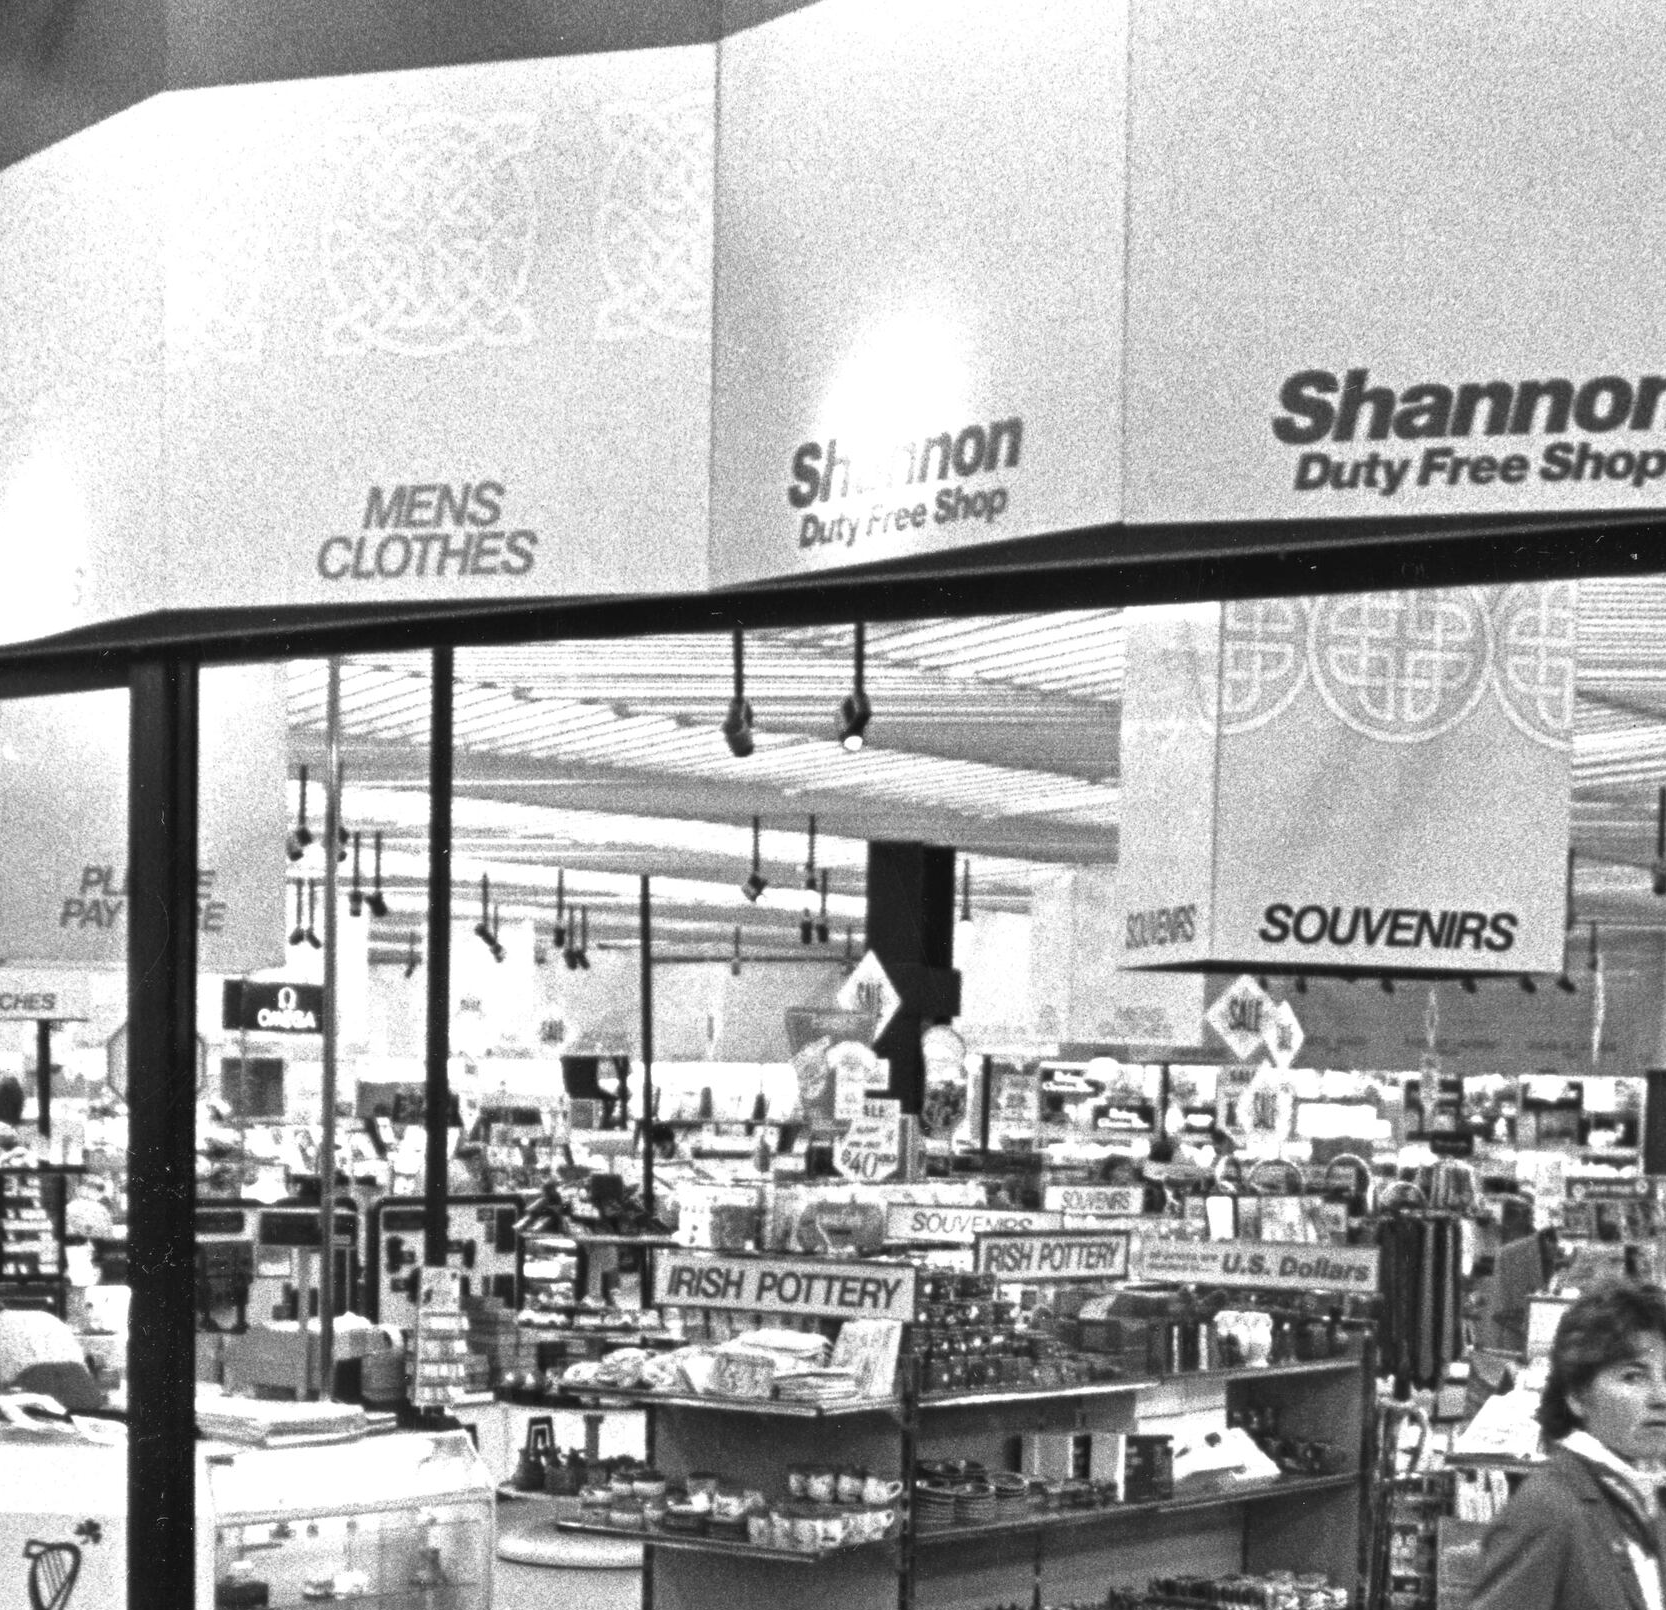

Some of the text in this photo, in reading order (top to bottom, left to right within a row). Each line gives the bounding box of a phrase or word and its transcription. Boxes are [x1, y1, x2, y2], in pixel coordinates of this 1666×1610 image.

[1293, 451, 1410, 497] Duty
[1417, 446, 1530, 487] Free
[362, 480, 505, 530] MENS
[799, 484, 1008, 549] Duty Free Shop
[317, 529, 538, 579] CLOTHES
[60, 898, 124, 928] PAY
[1259, 902, 1518, 952] SOUVENIRS
[257, 1008, 317, 1029] OMEGA
[1061, 1190, 1131, 1210] SOUVENIRS
[911, 1211, 1033, 1232] SOUVENIRS
[1038, 1241, 1120, 1272] POTTERY
[1222, 1253, 1270, 1276] U.S.
[1279, 1256, 1370, 1282] Dollars
[667, 1264, 902, 1309] IRISH POTTERY
